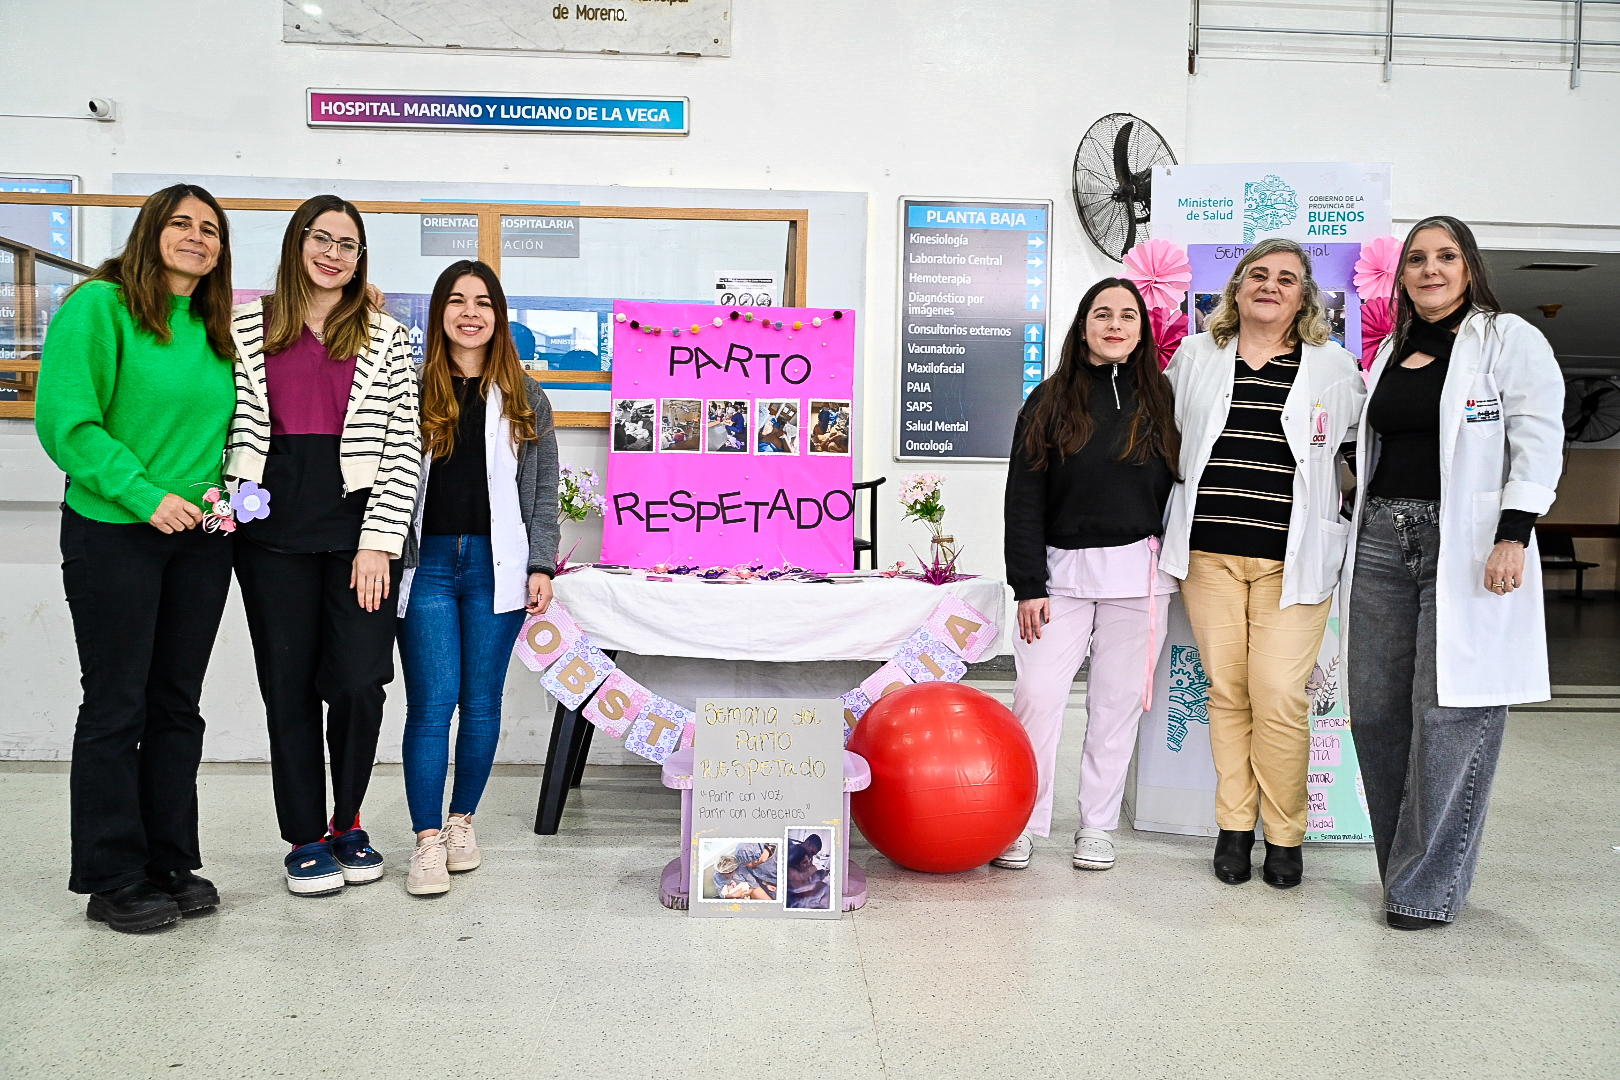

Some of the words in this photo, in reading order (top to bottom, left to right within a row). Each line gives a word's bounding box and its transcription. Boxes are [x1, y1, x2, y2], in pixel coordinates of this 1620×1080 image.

[552, 4, 569, 20] de
[576, 5, 627, 21] Moreno.
[320, 101, 400, 116] HOSPITAL
[404, 103, 482, 118] MARIANO
[485, 104, 498, 118] Y
[500, 104, 572, 120] LUCIANO
[575, 106, 598, 121] DE
[601, 107, 622, 121] LA
[625, 107, 671, 122] VEGA
[1178, 197, 1234, 208] Ministerio
[926, 210, 987, 225] PLANTA
[990, 212, 1027, 227] BAJA
[1186, 210, 1201, 221] de
[1202, 209, 1234, 221] Salud
[1308, 211, 1365, 222] BUENOS
[423, 217, 479, 228] ORIENTACI
[1307, 224, 1347, 236] AIRES
[452, 239, 544, 250] INFACIÓN
[909, 233, 969, 247] Kinesiología
[909, 252, 966, 265] Laboratorio
[968, 254, 1003, 266] Central
[909, 272, 972, 287] Hemoterapia
[908, 291, 966, 306] Diagnóstico
[967, 294, 984, 307] por
[908, 304, 955, 317] imágenes
[907, 323, 968, 336] Consultorios
[969, 325, 1012, 337] externos
[907, 343, 966, 355] Vacunatorio
[669, 342, 812, 385] PARTO
[907, 362, 965, 374] Maxilofacial
[906, 382, 932, 393] PAIA
[906, 401, 933, 412] SAPS
[905, 420, 933, 432] Salud
[934, 421, 969, 433] Mental
[905, 439, 953, 454] Oncología
[613, 488, 854, 533] RESPETADO
[1310, 734, 1341, 748] ación
[739, 791, 756, 802] con
[729, 808, 747, 820] con
